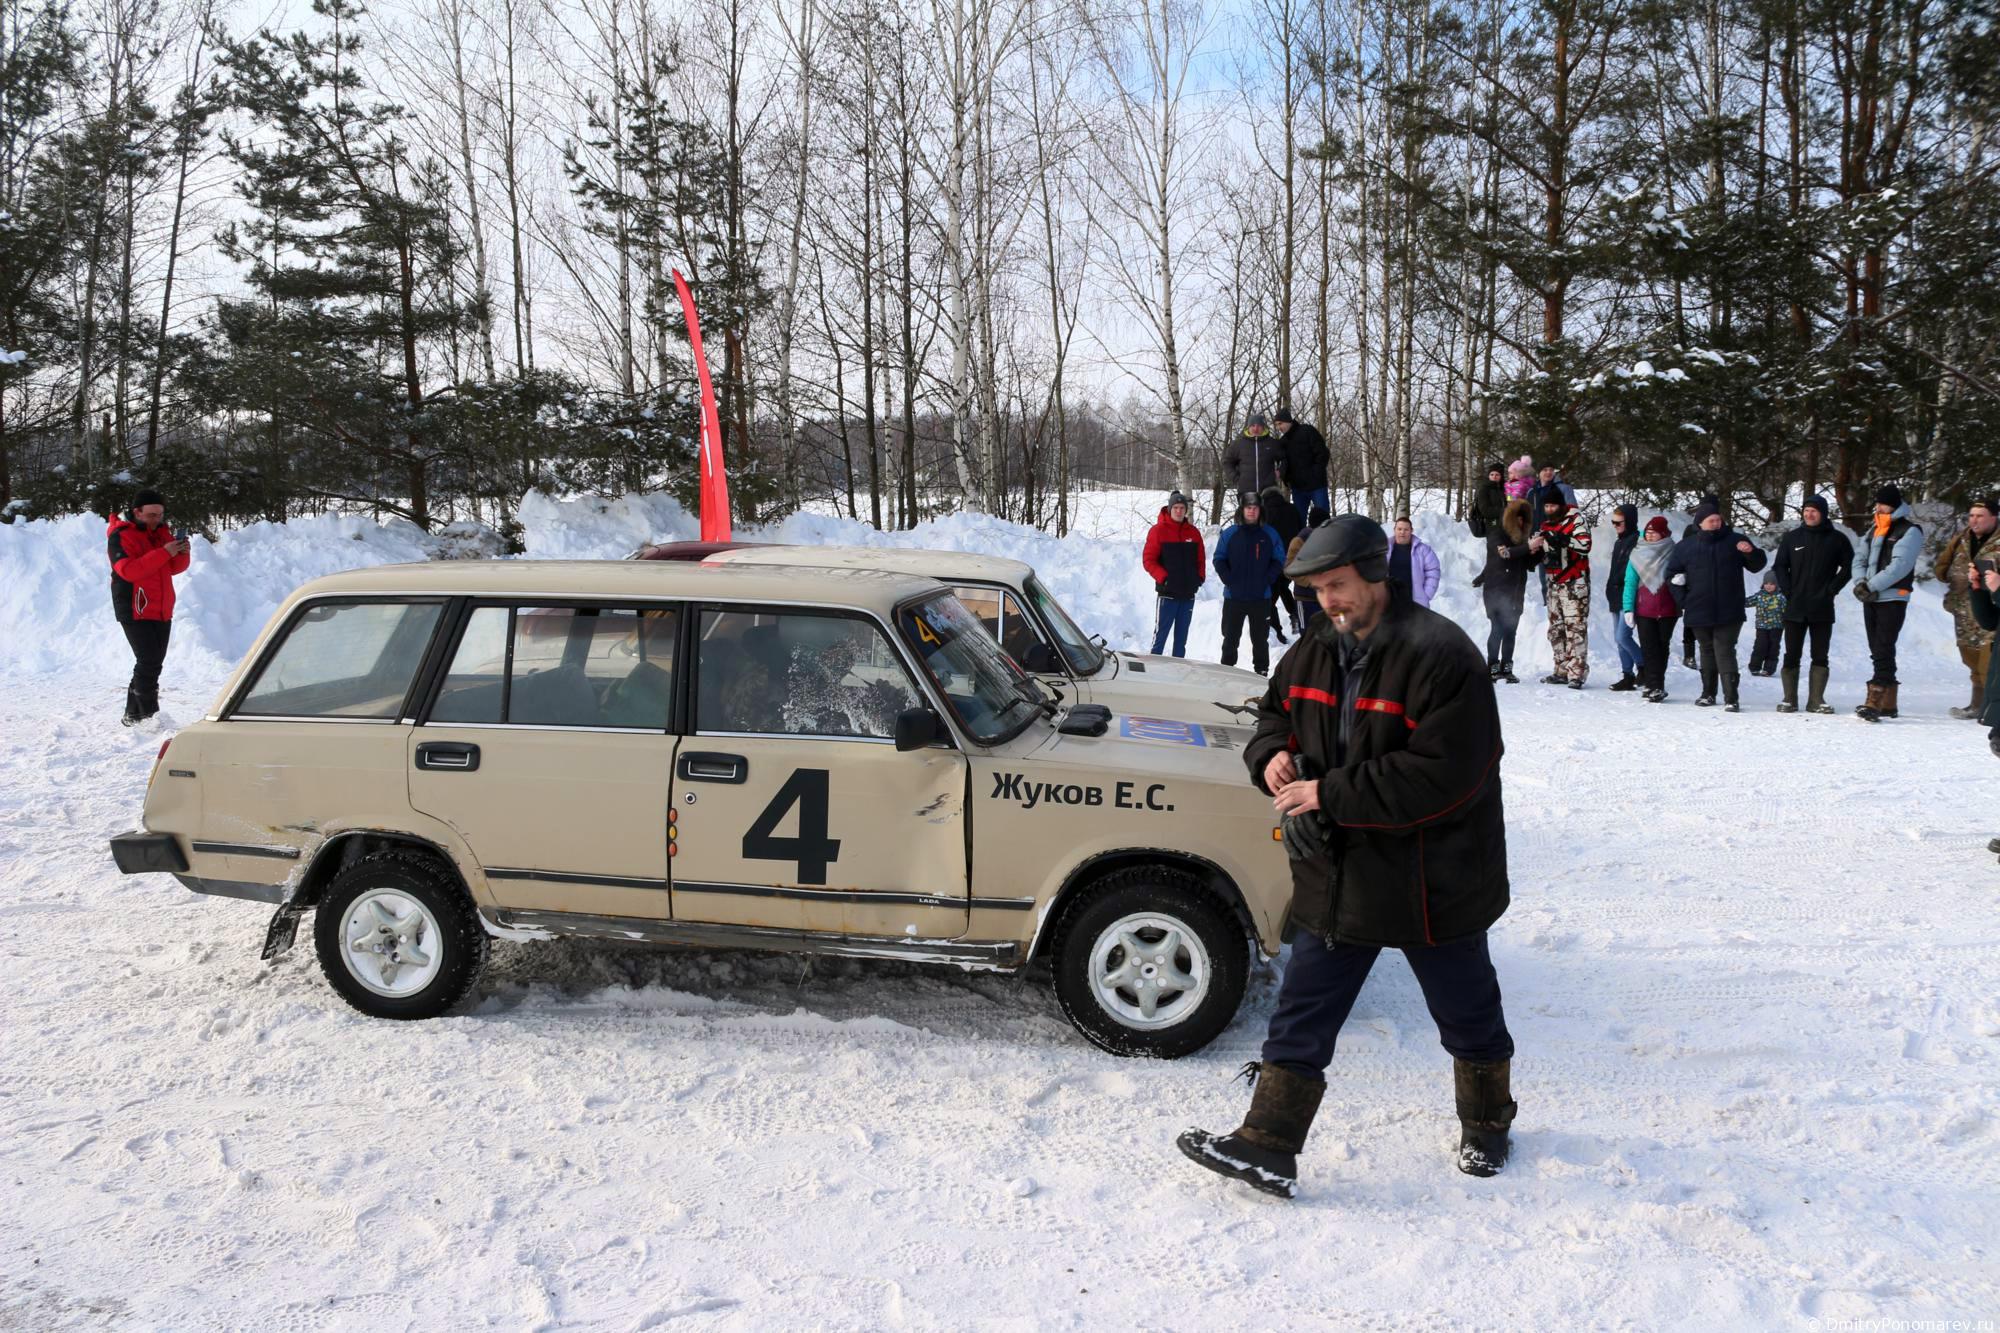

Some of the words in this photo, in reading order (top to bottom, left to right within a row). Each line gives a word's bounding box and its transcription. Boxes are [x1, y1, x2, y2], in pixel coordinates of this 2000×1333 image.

[914, 615, 942, 646] 4
[990, 772, 1104, 810] Жуков
[742, 767, 841, 886] 4
[918, 897, 940, 905] LADA
